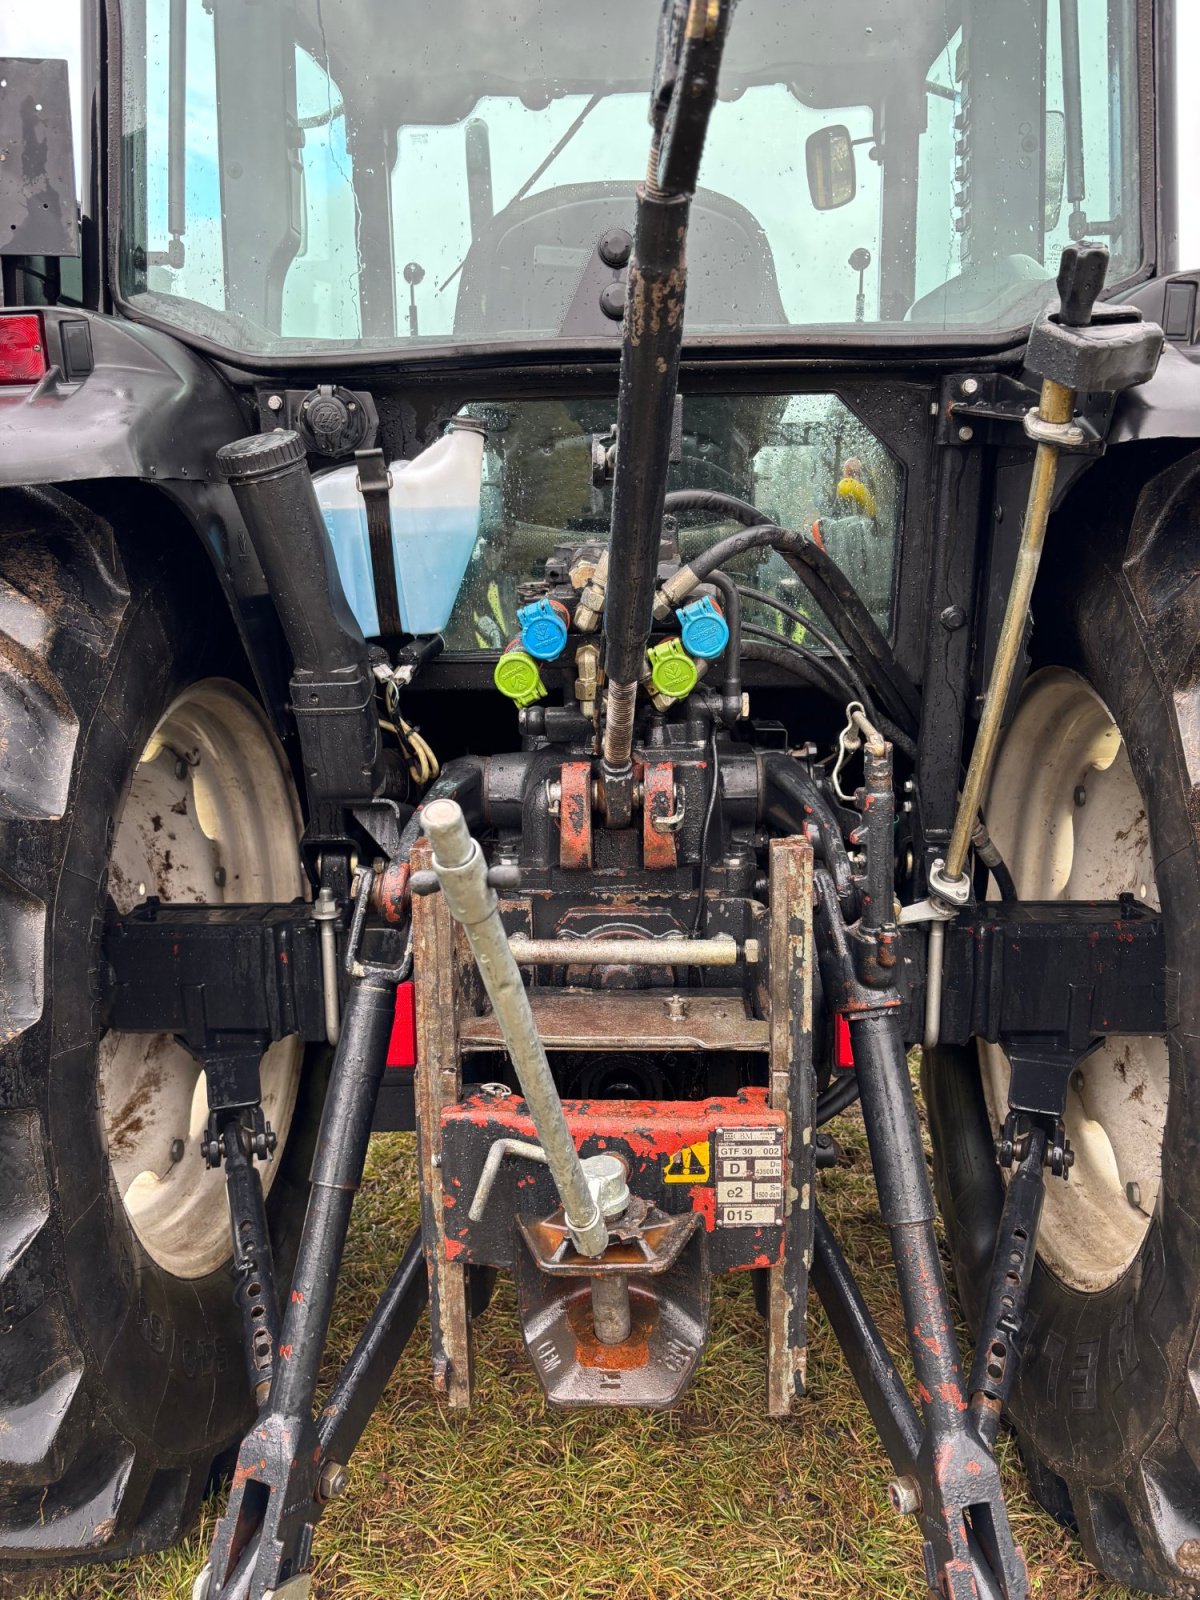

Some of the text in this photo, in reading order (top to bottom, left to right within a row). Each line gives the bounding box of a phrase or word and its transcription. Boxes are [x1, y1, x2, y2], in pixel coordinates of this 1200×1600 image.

[730, 1163, 740, 1174] D
[727, 1187, 743, 1198] e2
[727, 1210, 752, 1221] 015
